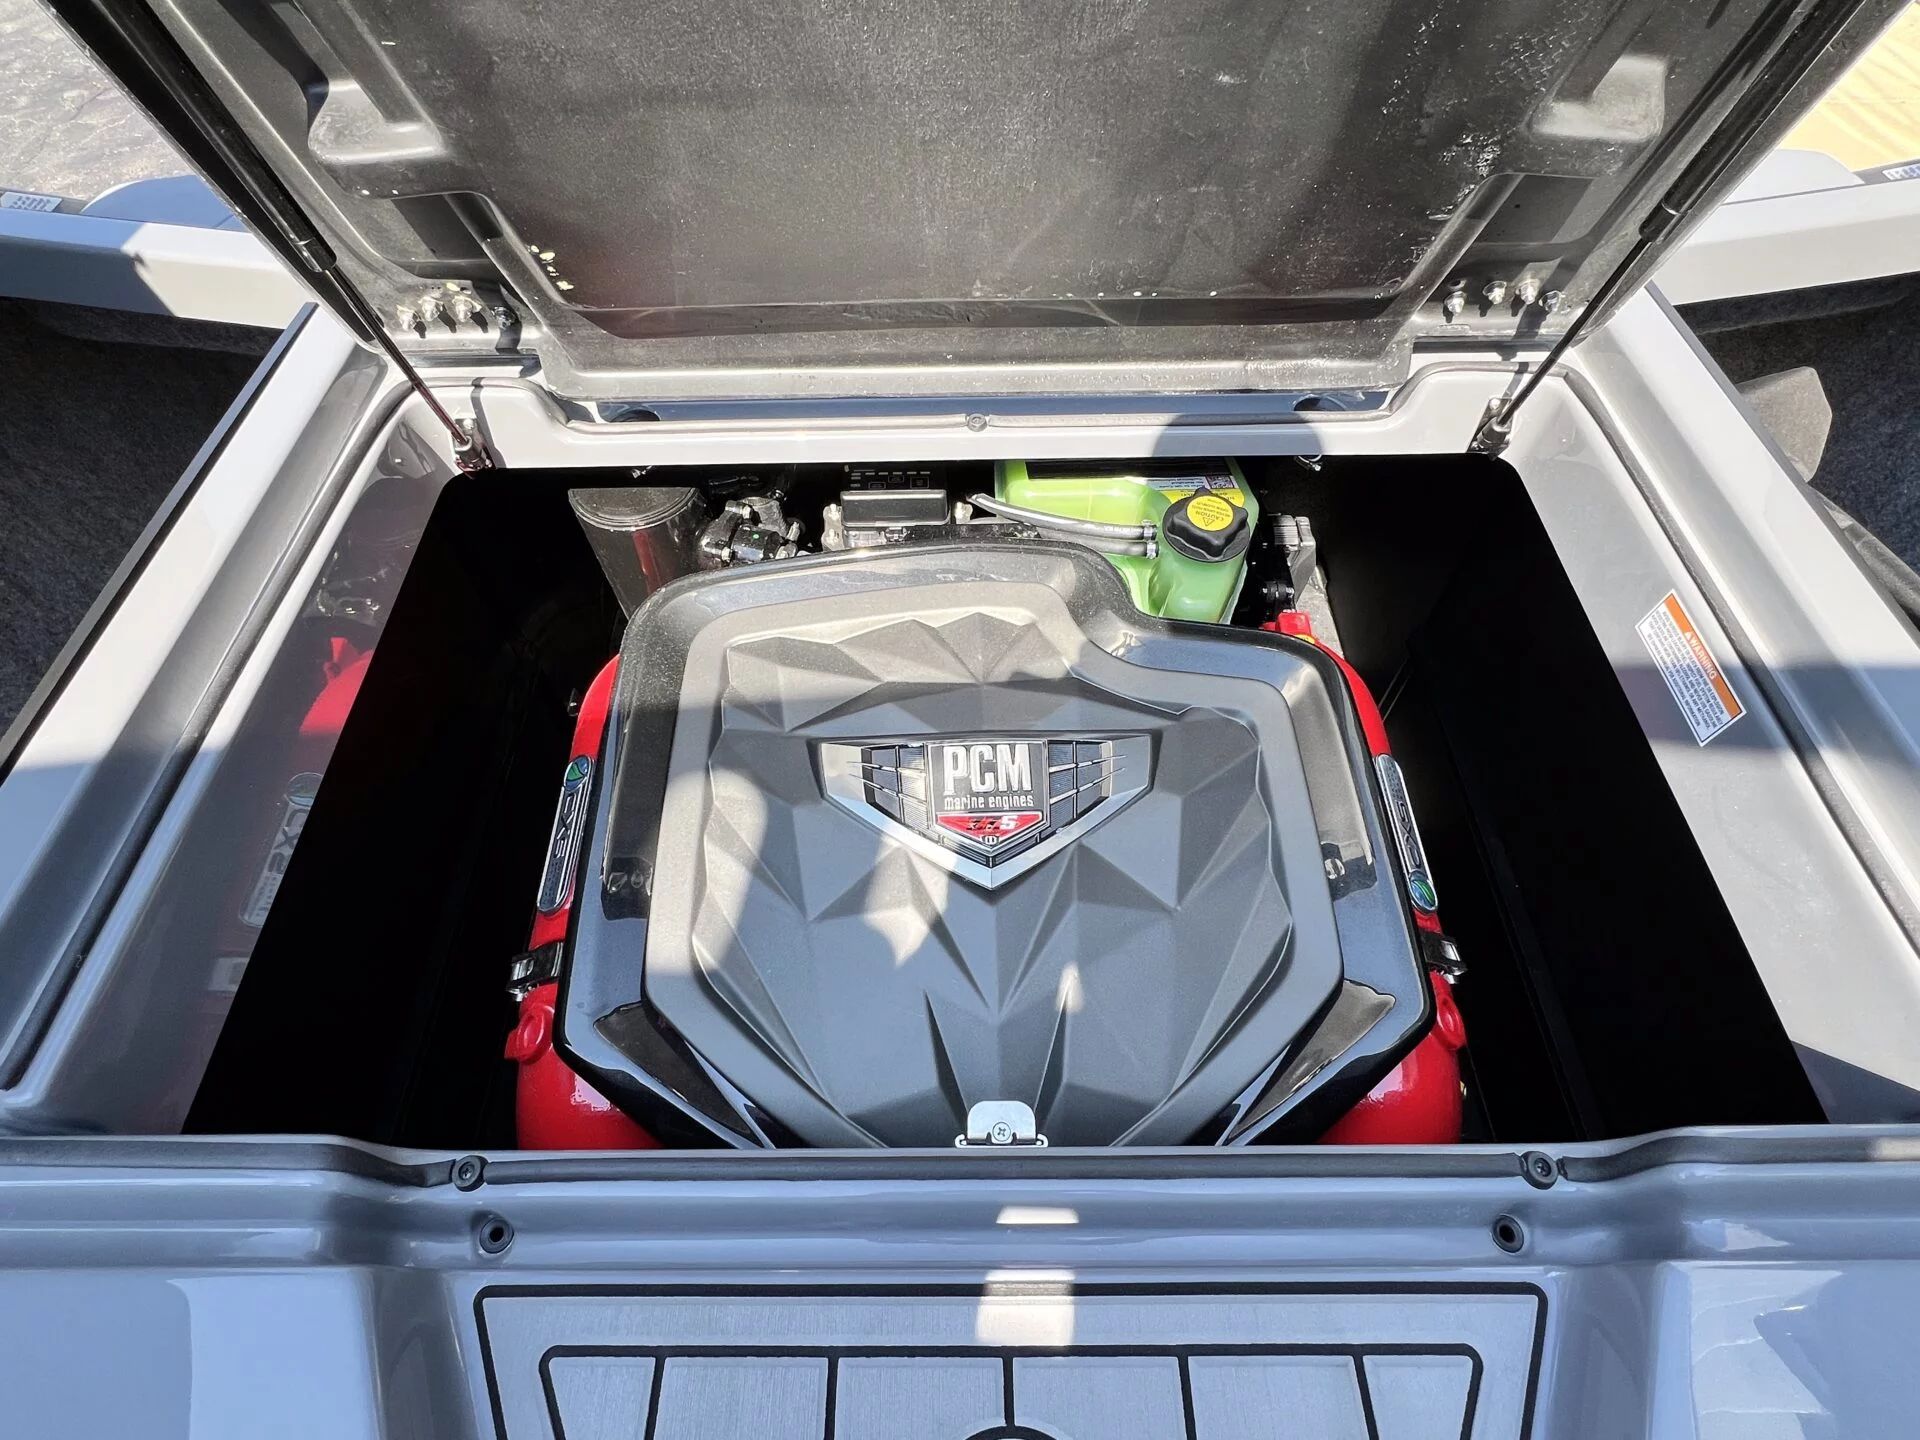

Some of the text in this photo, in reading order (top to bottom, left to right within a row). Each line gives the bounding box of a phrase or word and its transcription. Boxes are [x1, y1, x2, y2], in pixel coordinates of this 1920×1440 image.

[1195, 511, 1224, 521] CAUTION
[1688, 636, 1717, 680] WARNING
[943, 744, 1032, 796] PCM
[944, 794, 1034, 810] marine engines
